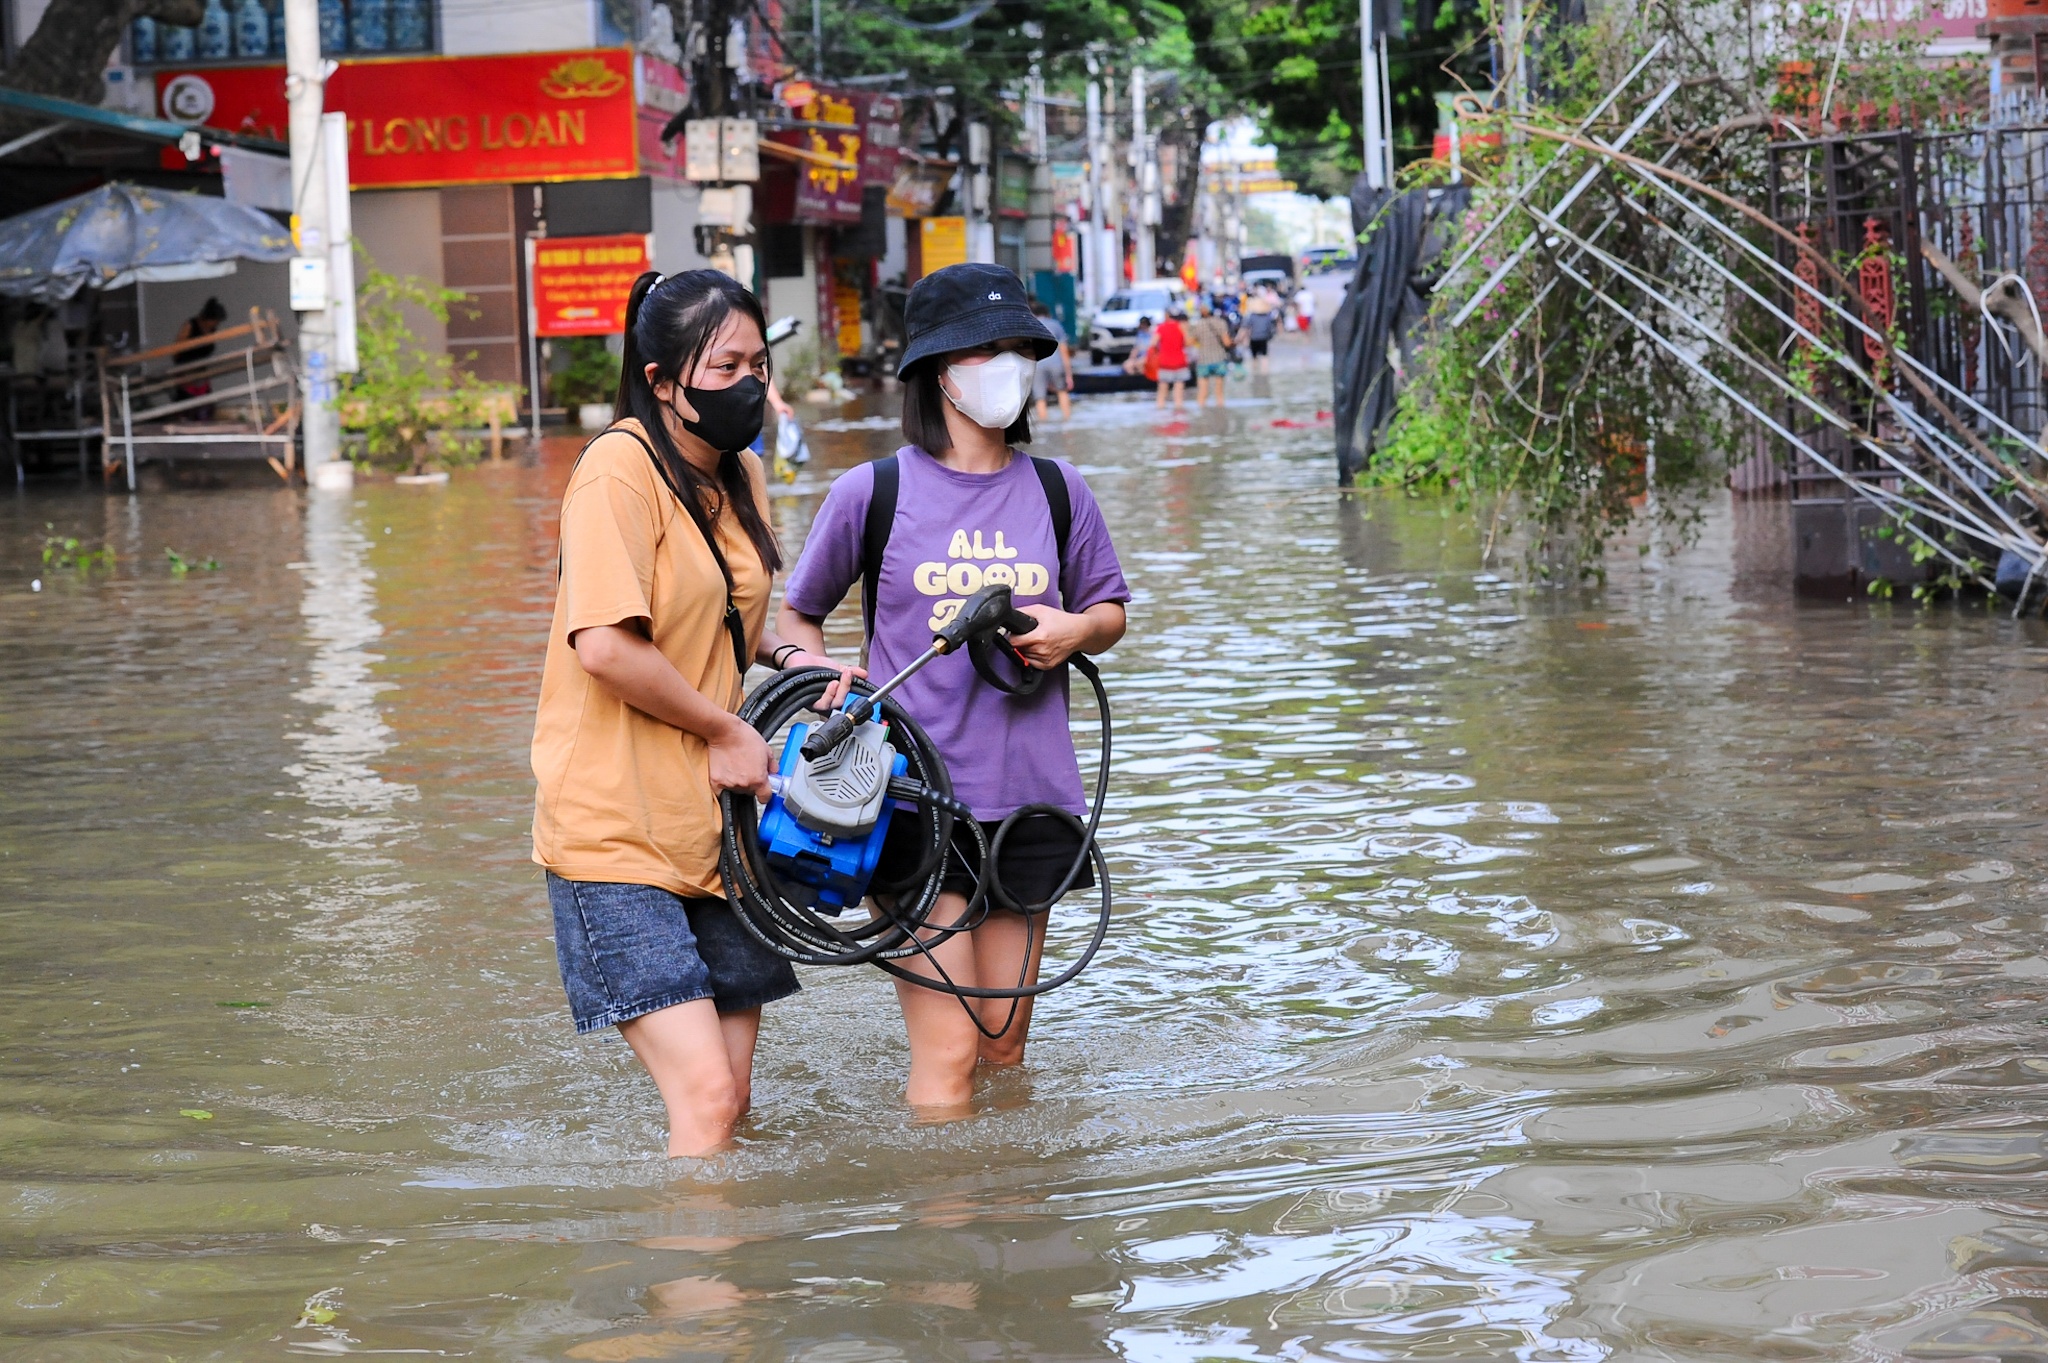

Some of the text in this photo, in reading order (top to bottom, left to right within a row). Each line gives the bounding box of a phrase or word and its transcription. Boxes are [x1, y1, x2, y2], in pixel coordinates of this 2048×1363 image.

[363, 116, 468, 155] LONG
[480, 109, 586, 150] LOAN
[988, 291, 1002, 300] da
[948, 529, 1018, 559] ALL
[913, 562, 1049, 596] GOOD
[777, 945, 798, 957] CHENG
[899, 948, 913, 956] HAO
